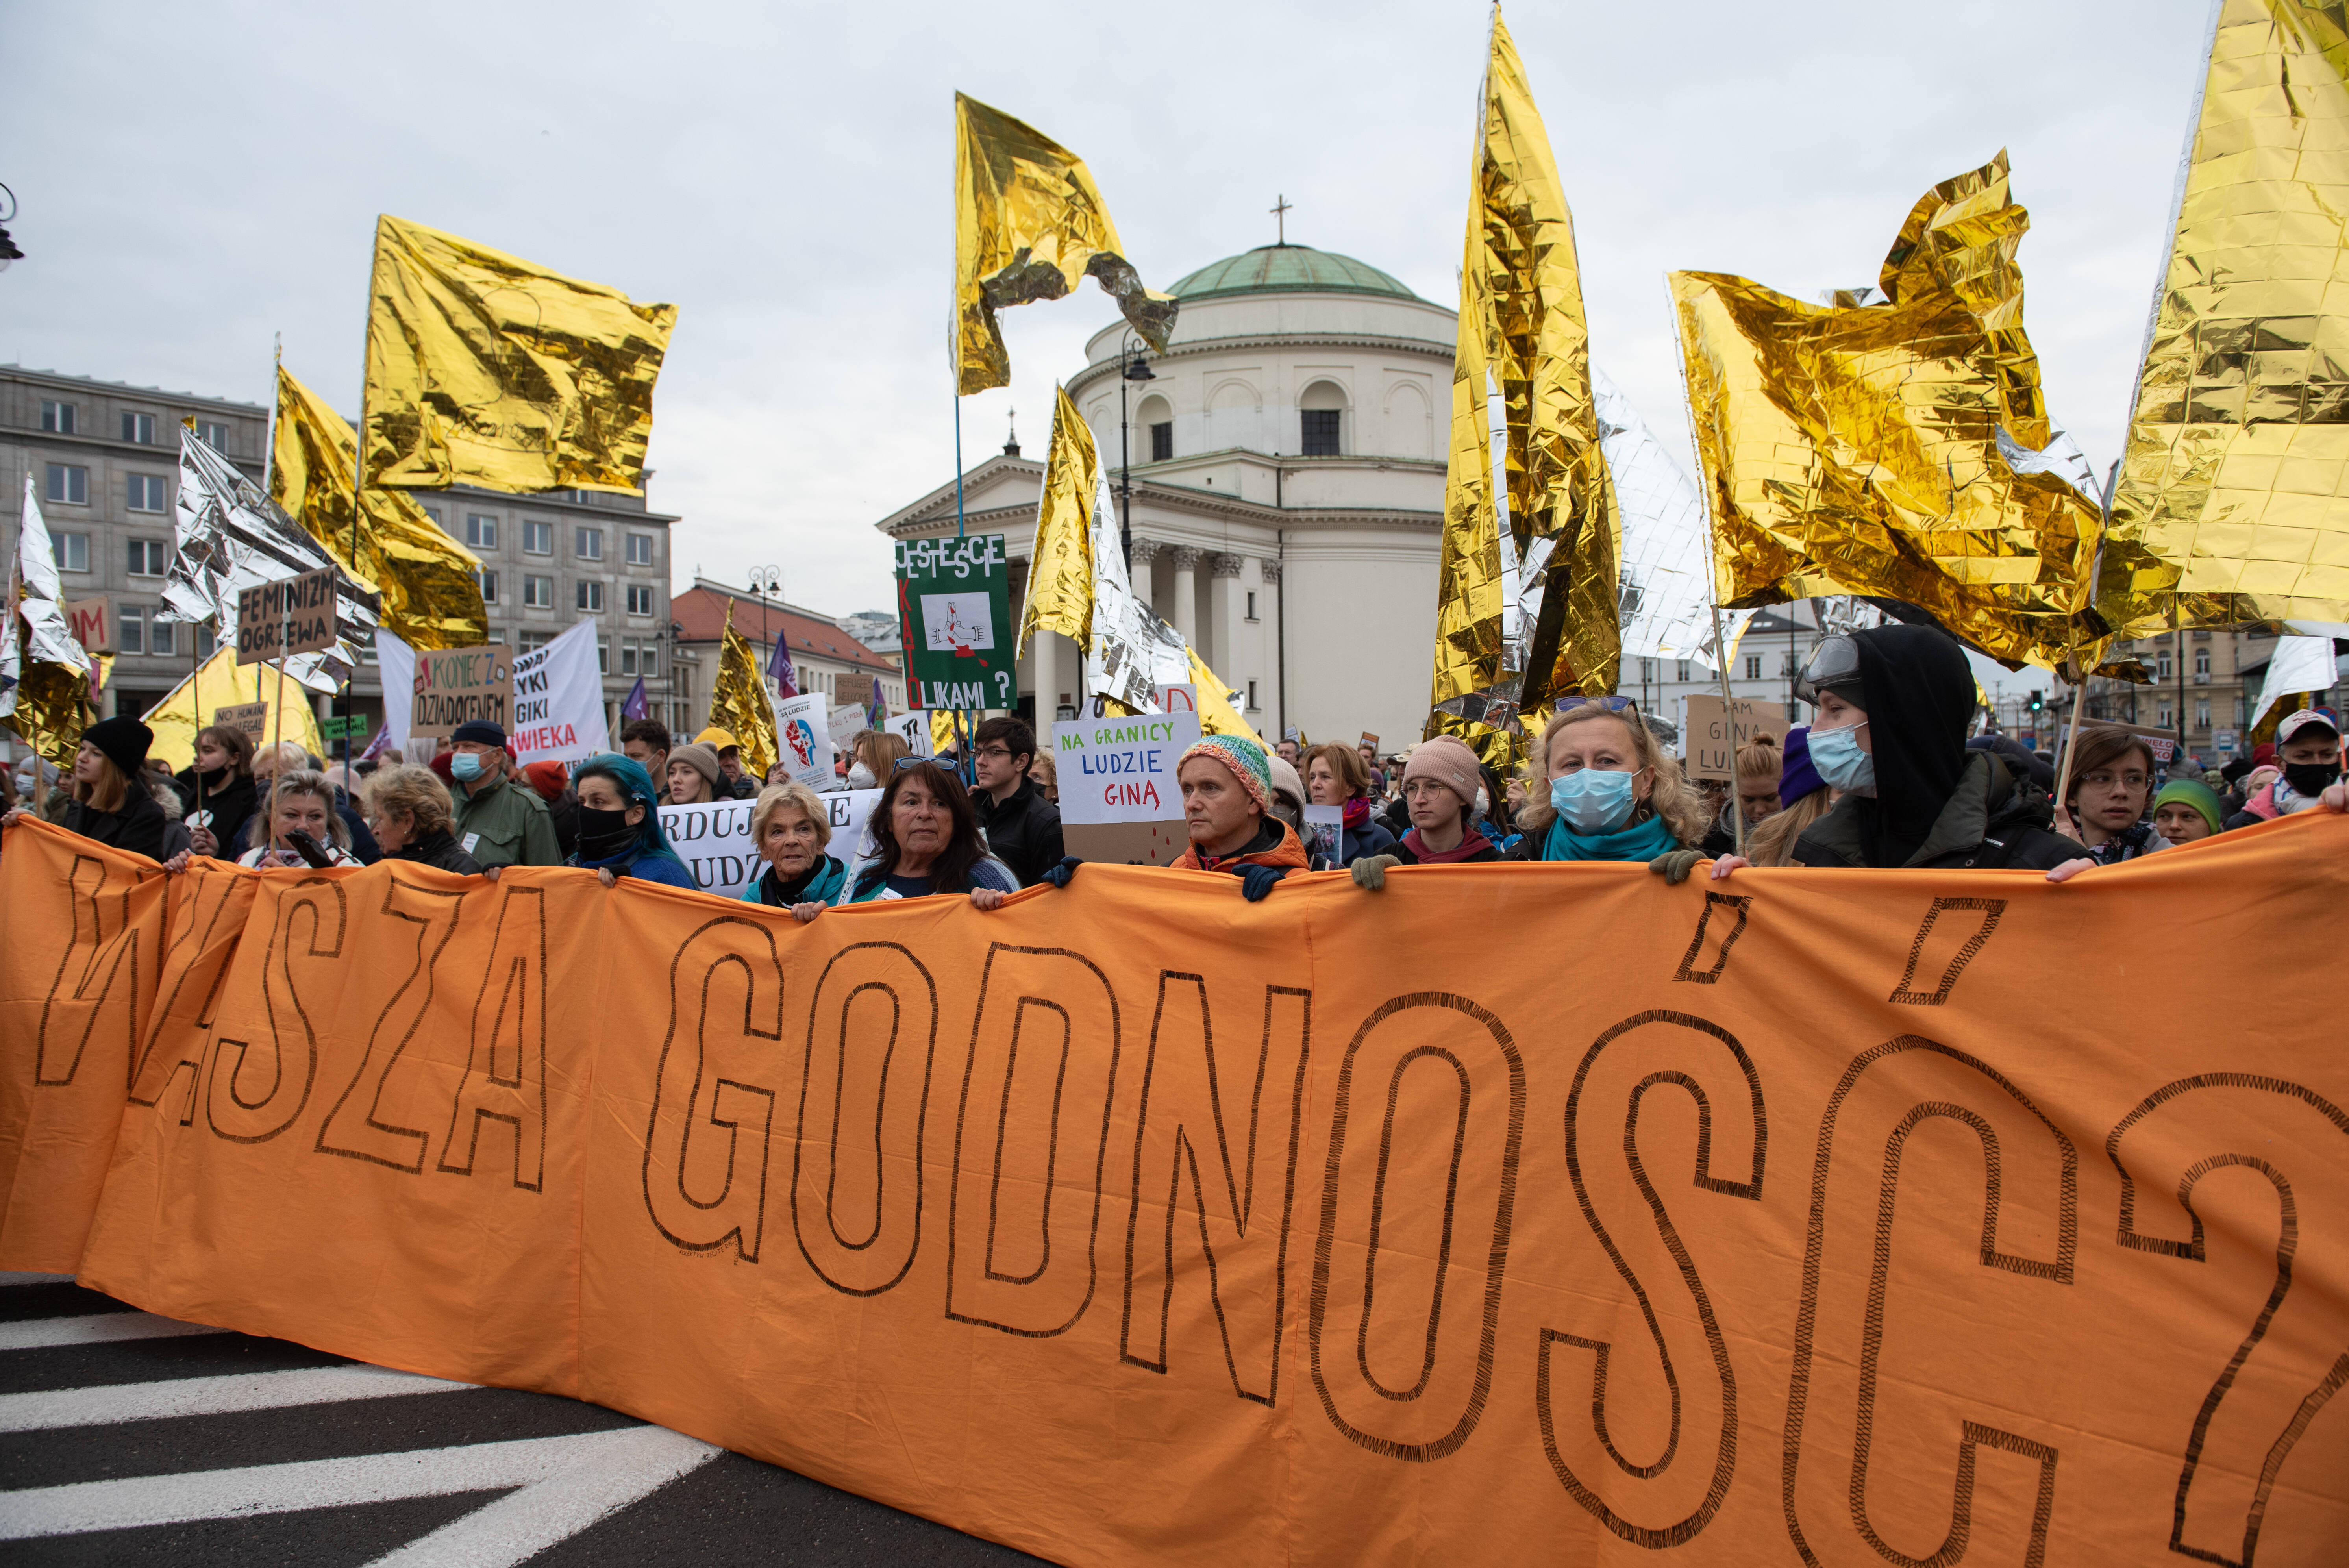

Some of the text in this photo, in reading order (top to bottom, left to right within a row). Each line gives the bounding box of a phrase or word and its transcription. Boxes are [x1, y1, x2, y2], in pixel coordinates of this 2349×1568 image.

[896, 535, 1005, 578] JESTEŚCIE
[239, 570, 334, 624] FEMINIZM
[240, 616, 327, 653] OGRZEWA
[433, 654, 481, 689] KONIEC
[485, 653, 494, 685] Z
[513, 671, 548, 696] YKI
[837, 677, 872, 689] REFUGEES
[788, 705, 811, 715] LUDZIE
[837, 692, 871, 702] WELCOME
[217, 704, 264, 722] NO HUMAN
[1062, 722, 1174, 751] NA GRANICY
[1082, 750, 1162, 774] LUDZIE
[1105, 780, 1161, 811] GINĄ
